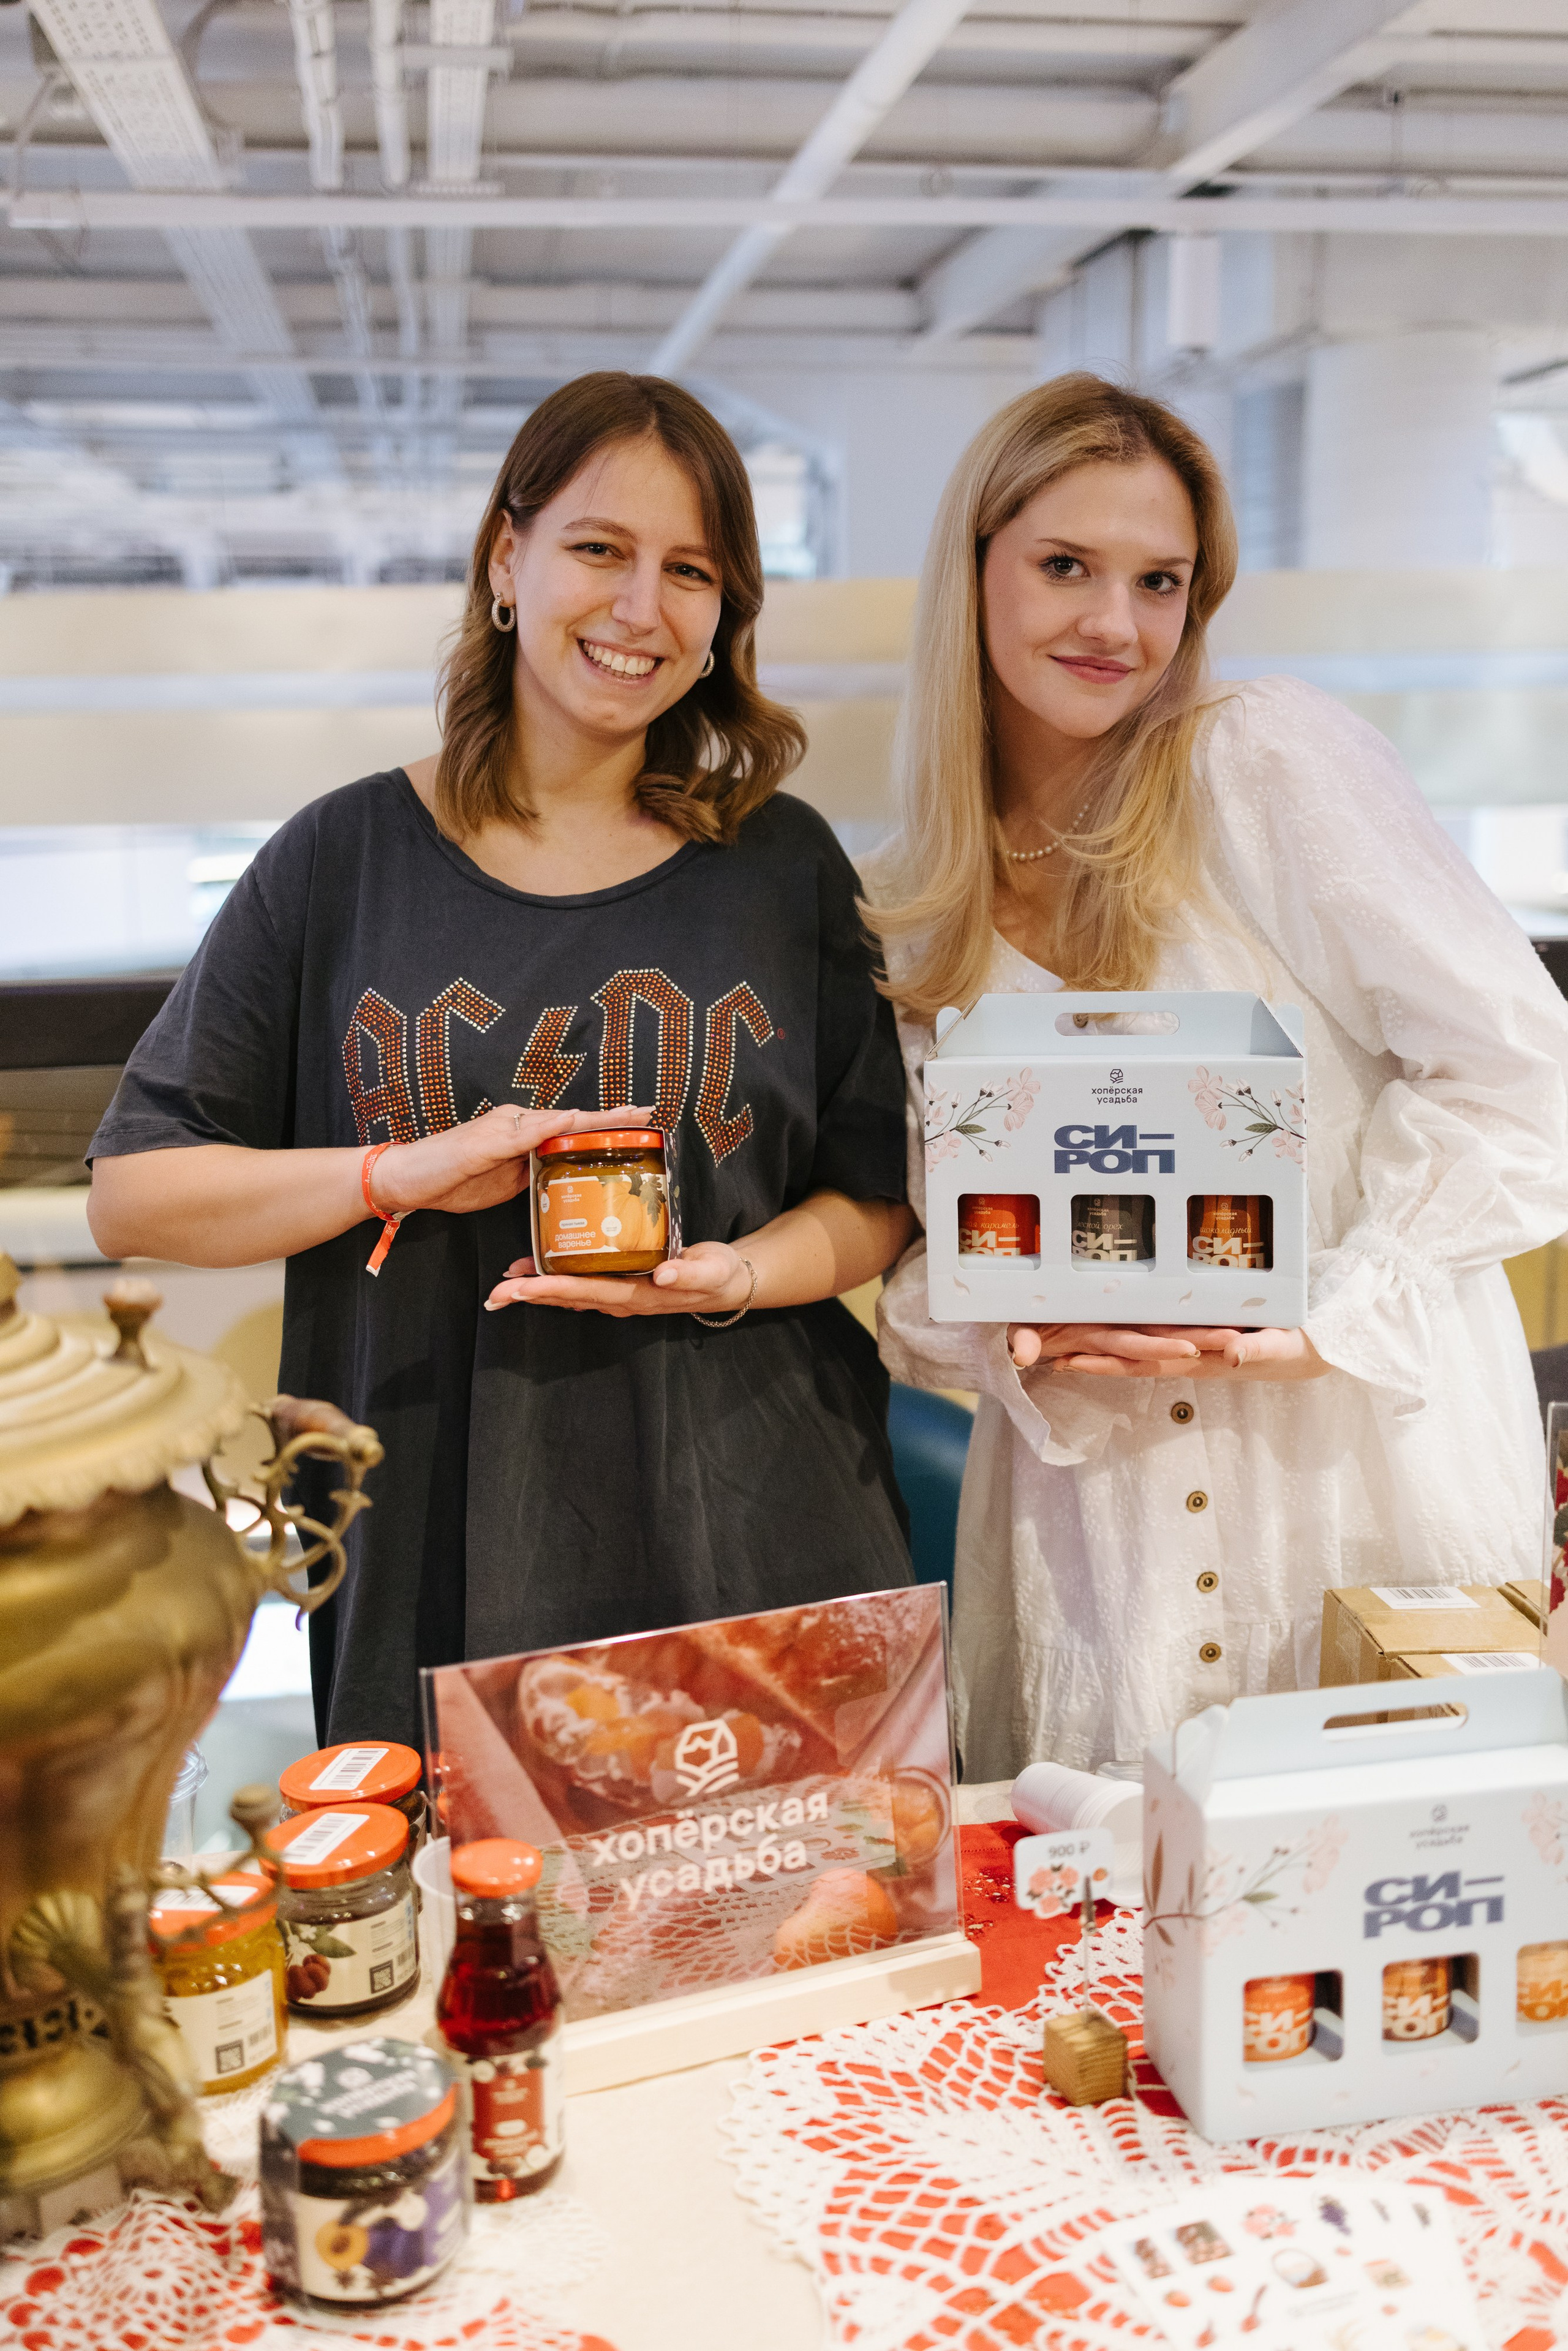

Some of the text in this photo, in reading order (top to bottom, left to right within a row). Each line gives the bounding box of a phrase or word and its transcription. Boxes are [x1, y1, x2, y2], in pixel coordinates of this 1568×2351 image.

[1091, 1086, 1143, 1096] хопёрская
[1096, 1095, 1137, 1105] усадьба
[1054, 1149, 1175, 1174] РОП
[1103, 1223, 1123, 1232] орех
[1200, 1226, 1252, 1237] шоколадный
[554, 1231, 596, 1242] домашнее
[558, 1239, 592, 1250] варенье
[590, 1791, 830, 1869] хопёрская
[617, 1835, 808, 1911] усадьба
[1363, 1894, 1505, 1939] РОП
